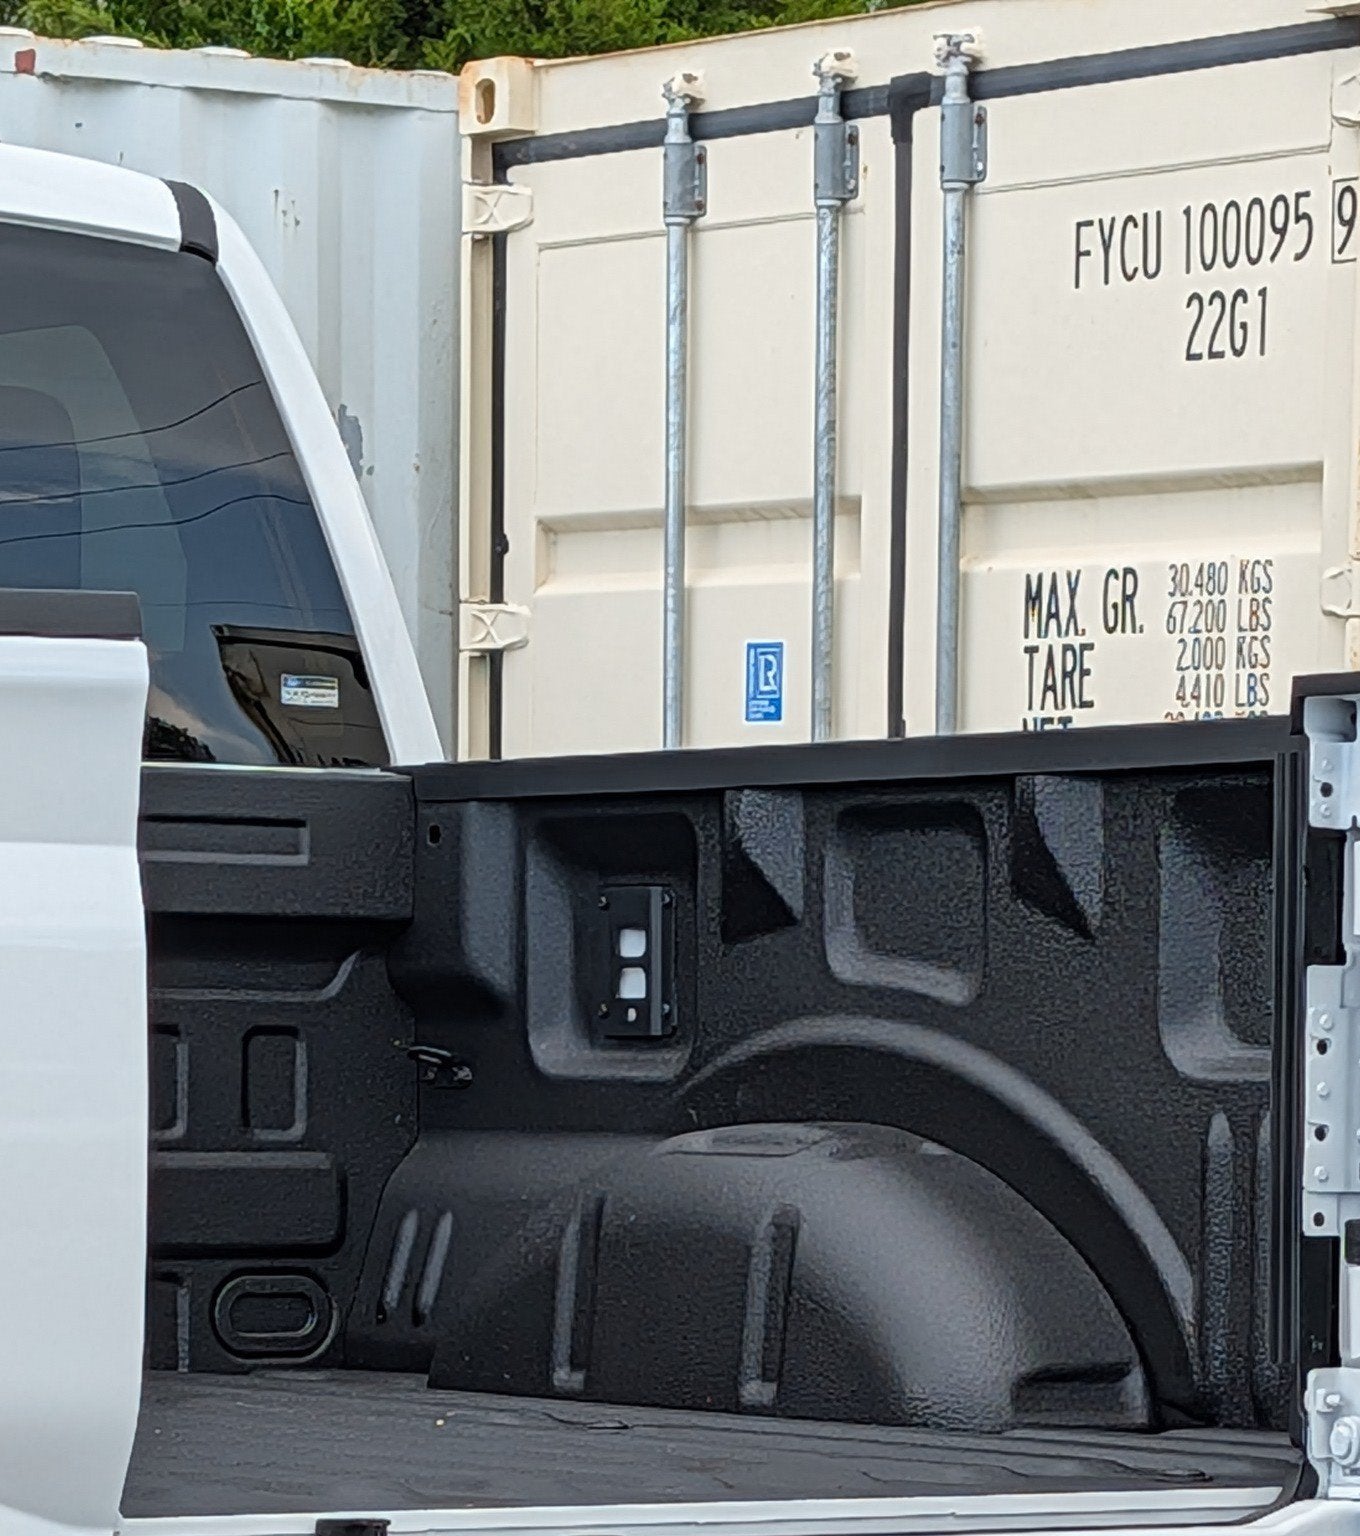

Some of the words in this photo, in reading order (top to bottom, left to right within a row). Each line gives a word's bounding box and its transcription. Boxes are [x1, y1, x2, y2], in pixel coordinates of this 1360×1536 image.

[1074, 210, 1163, 289] FYCU
[1183, 191, 1313, 275] 100095
[1337, 185, 1357, 255] 9
[1185, 286, 1268, 361] 22G1
[1024, 569, 1086, 638] MAX.
[1103, 567, 1144, 635] GR.
[1168, 561, 1228, 597] 30.480
[1238, 559, 1273, 594] KGS
[1237, 597, 1272, 632] LBS
[1024, 642, 1094, 711] TARE
[1235, 634, 1271, 670] KGS
[1235, 672, 1270, 707] LBS
